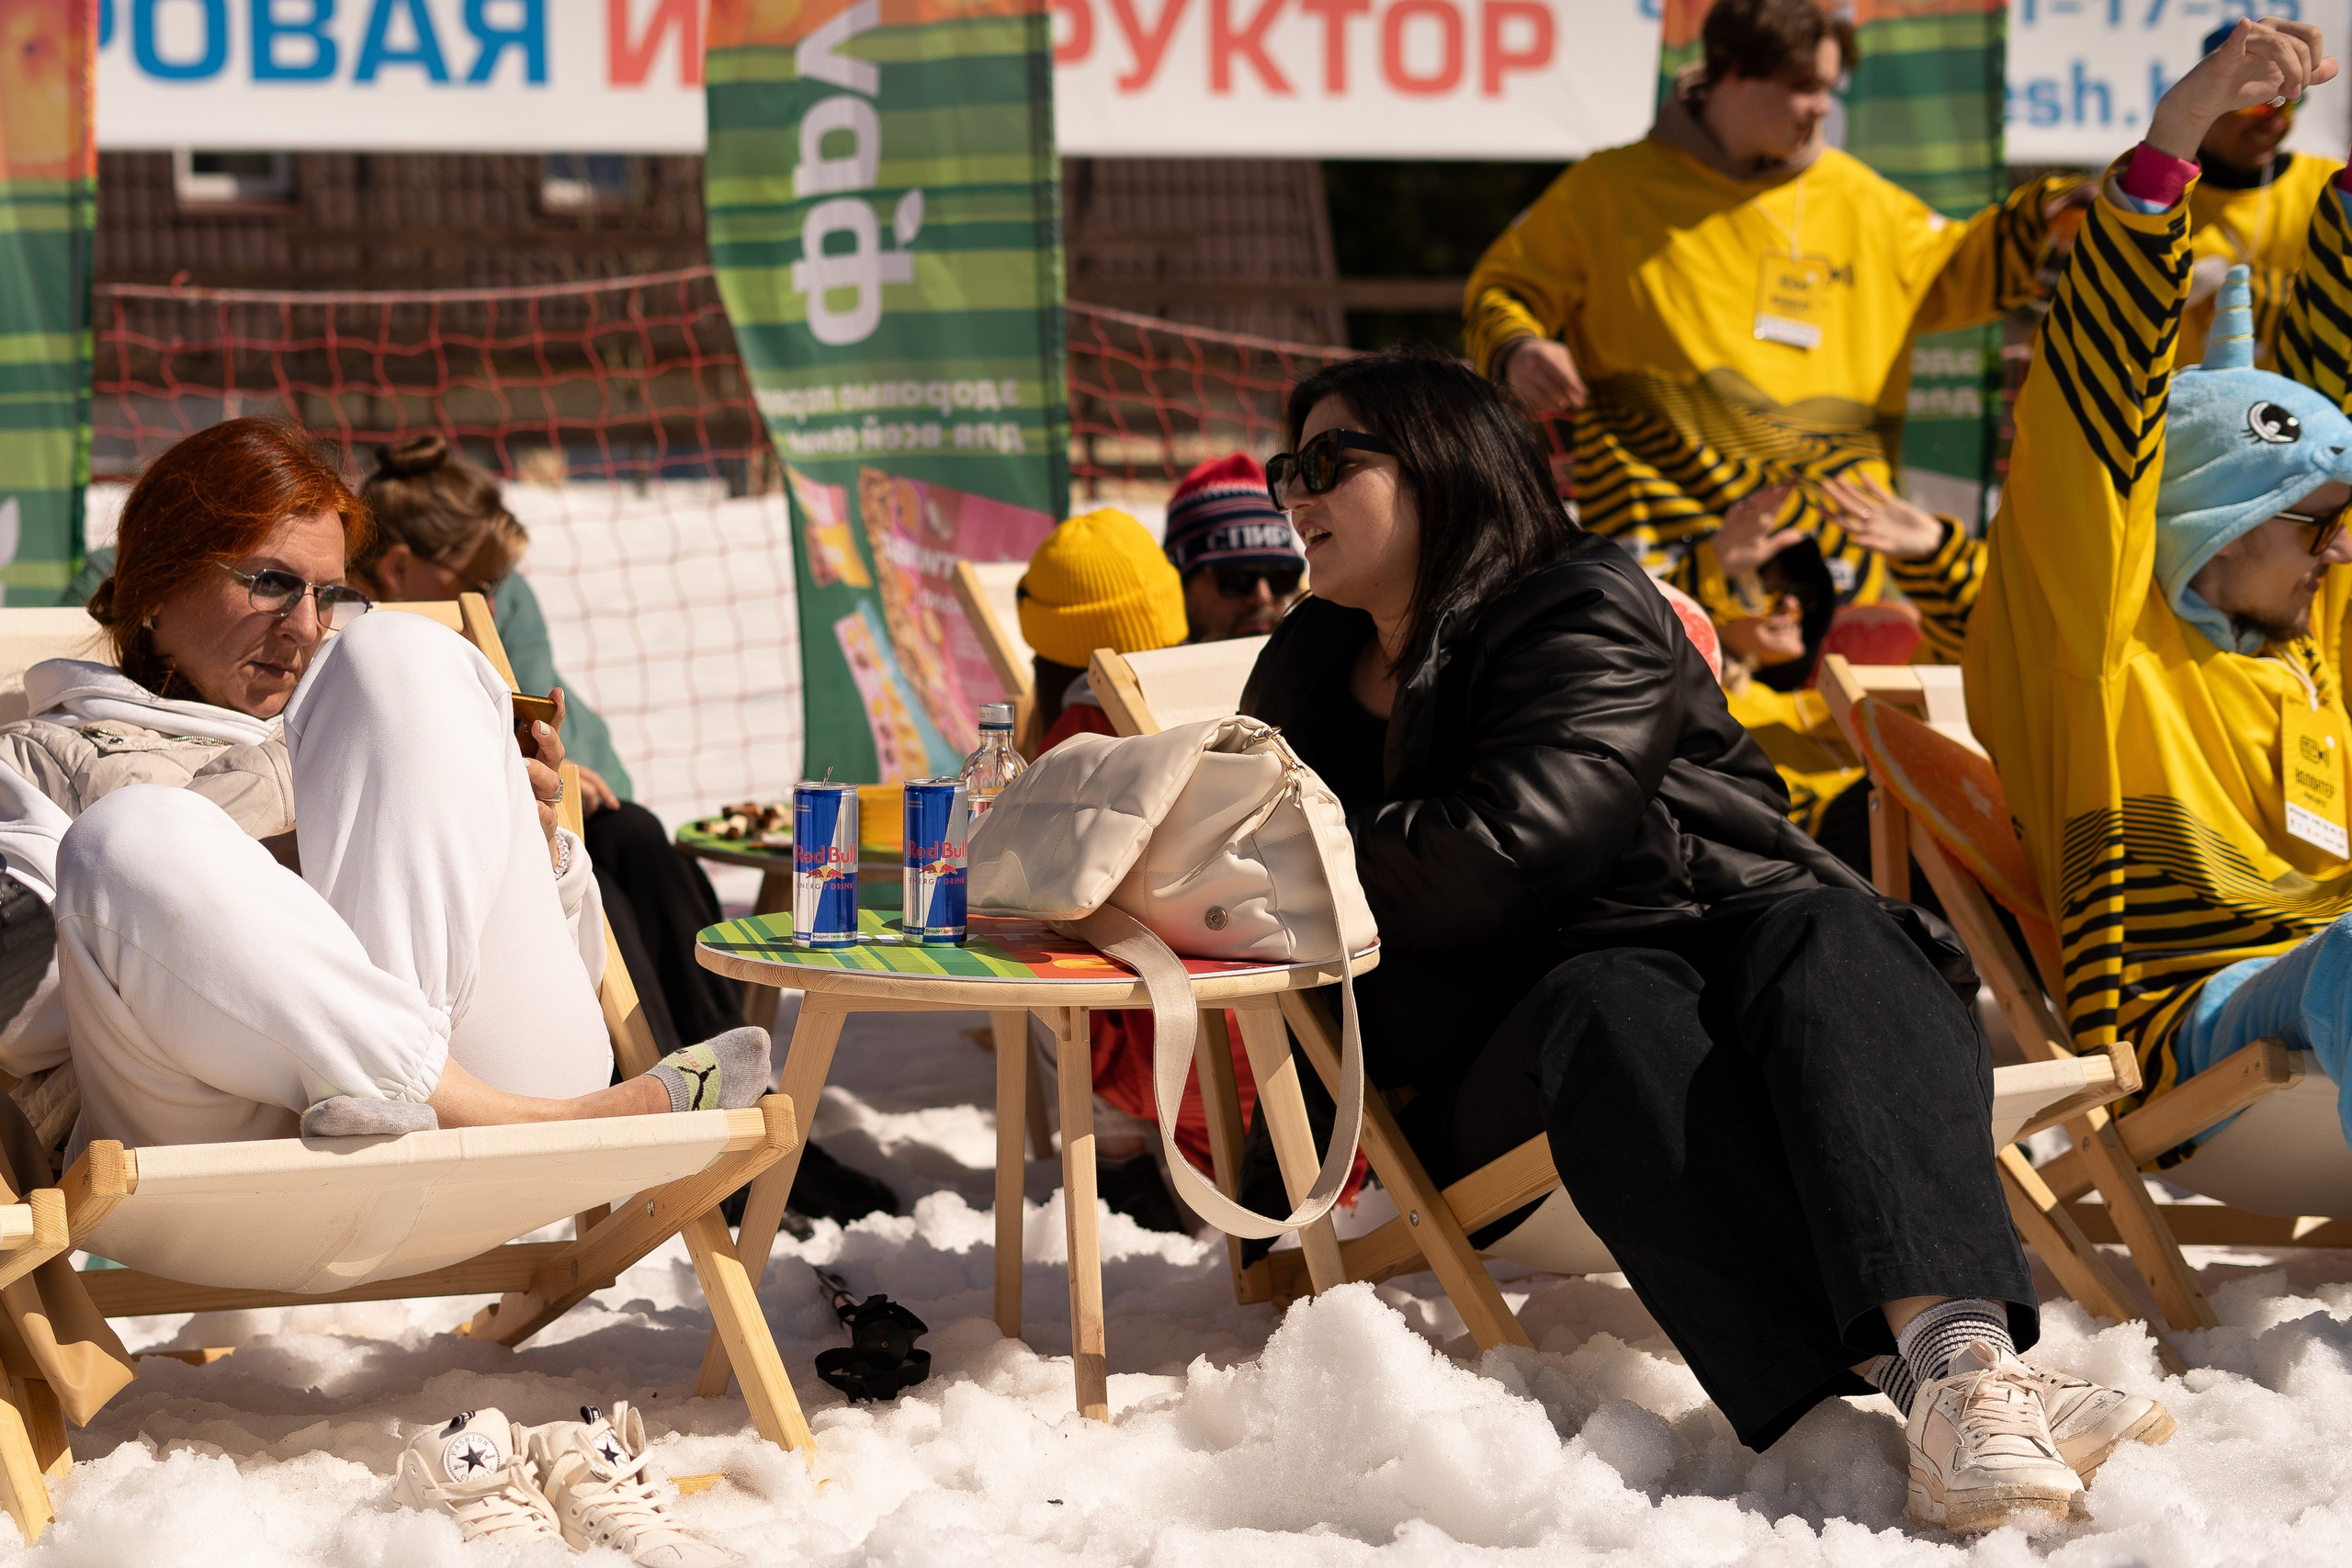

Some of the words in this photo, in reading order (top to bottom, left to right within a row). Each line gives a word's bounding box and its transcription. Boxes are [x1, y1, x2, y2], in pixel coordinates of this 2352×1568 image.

[98, 0, 549, 86] ОВАЯ
[796, 844, 826, 863] Red
[828, 843, 857, 863] Bull
[908, 840, 939, 859] Red
[941, 840, 967, 859] Bull
[797, 883, 828, 891] ENERGY
[830, 882, 854, 891] DRINK
[910, 876, 941, 886] ENERGY
[944, 877, 965, 886] DRINK
[450, 1436, 490, 1456] FASHION
